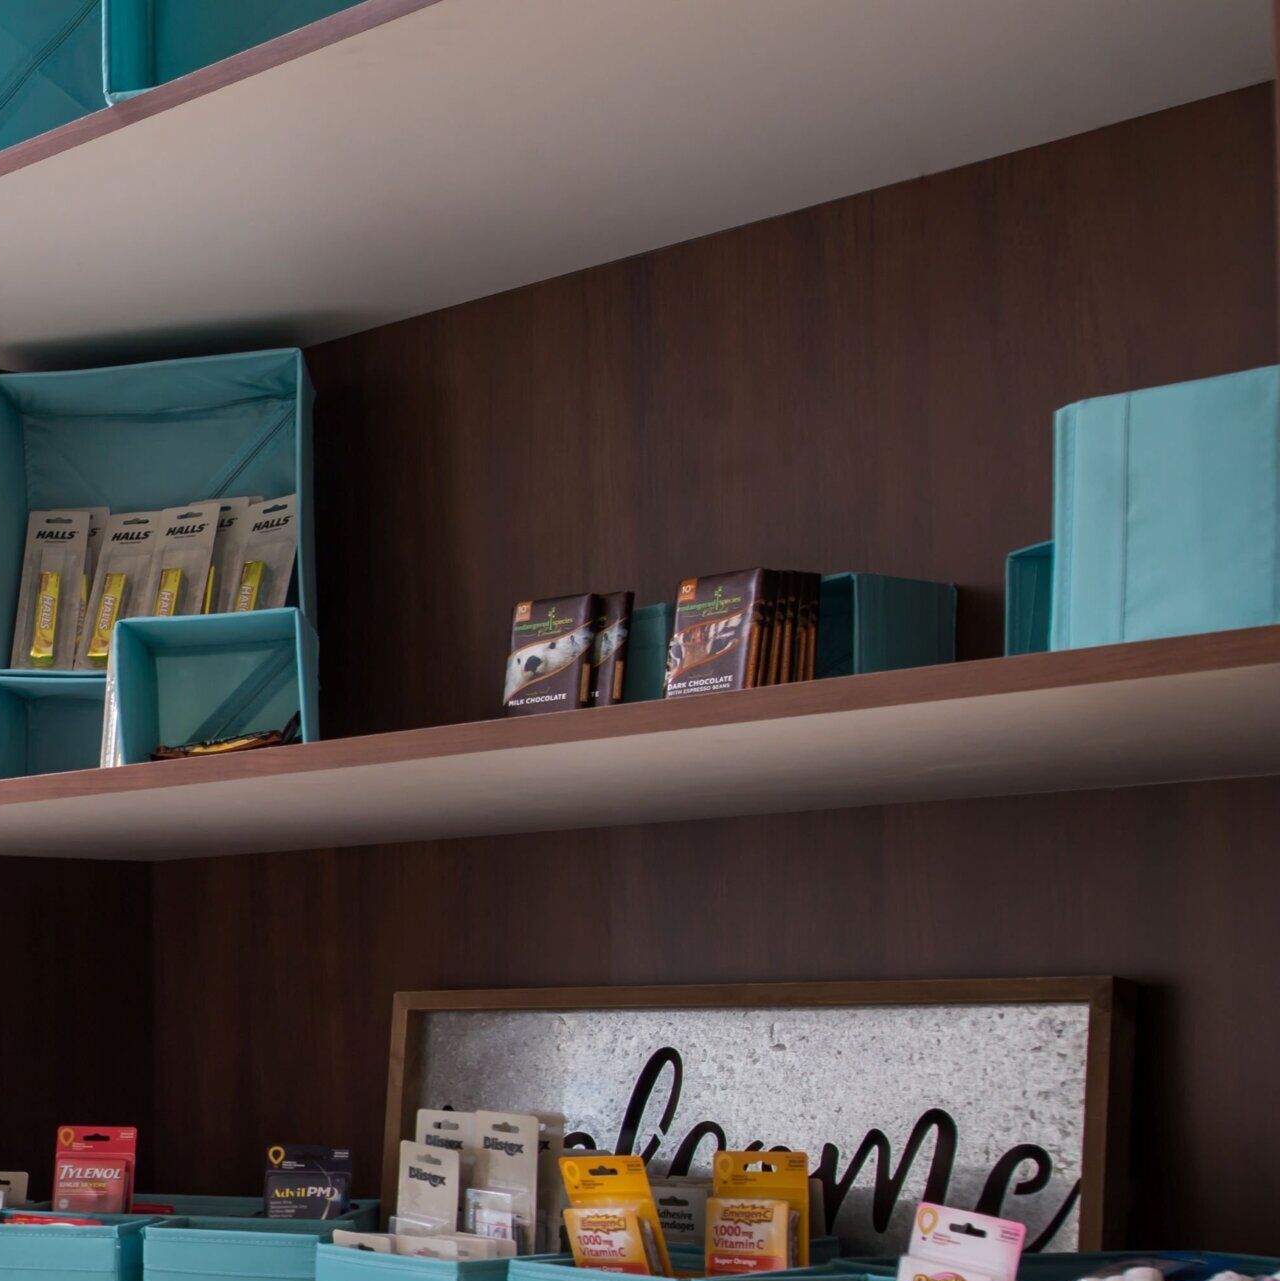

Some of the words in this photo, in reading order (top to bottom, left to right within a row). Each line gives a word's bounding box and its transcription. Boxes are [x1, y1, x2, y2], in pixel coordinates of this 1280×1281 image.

[253, 516, 290, 532] HALLS
[36, 530, 77, 540] HALLS
[111, 531, 150, 542] HALLS
[166, 524, 206, 537] HALLS
[667, 682, 686, 691] DARK
[688, 675, 733, 687] CHOCOLATE
[509, 699, 524, 707] MILK
[526, 693, 567, 704] CHOCOLATE
[60, 1165, 120, 1180] TYLENOL
[272, 1187, 305, 1198] Advil
[306, 1186, 331, 1197] PM
[722, 1208, 773, 1220] Emergen-C
[741, 1229, 754, 1239] mg
[714, 1238, 754, 1249] Vitamin
[757, 1238, 765, 1249] C
[580, 1247, 616, 1257] Vitamin
[617, 1248, 626, 1257] C
[714, 1257, 733, 1267] Super
[735, 1256, 757, 1267] Orange
